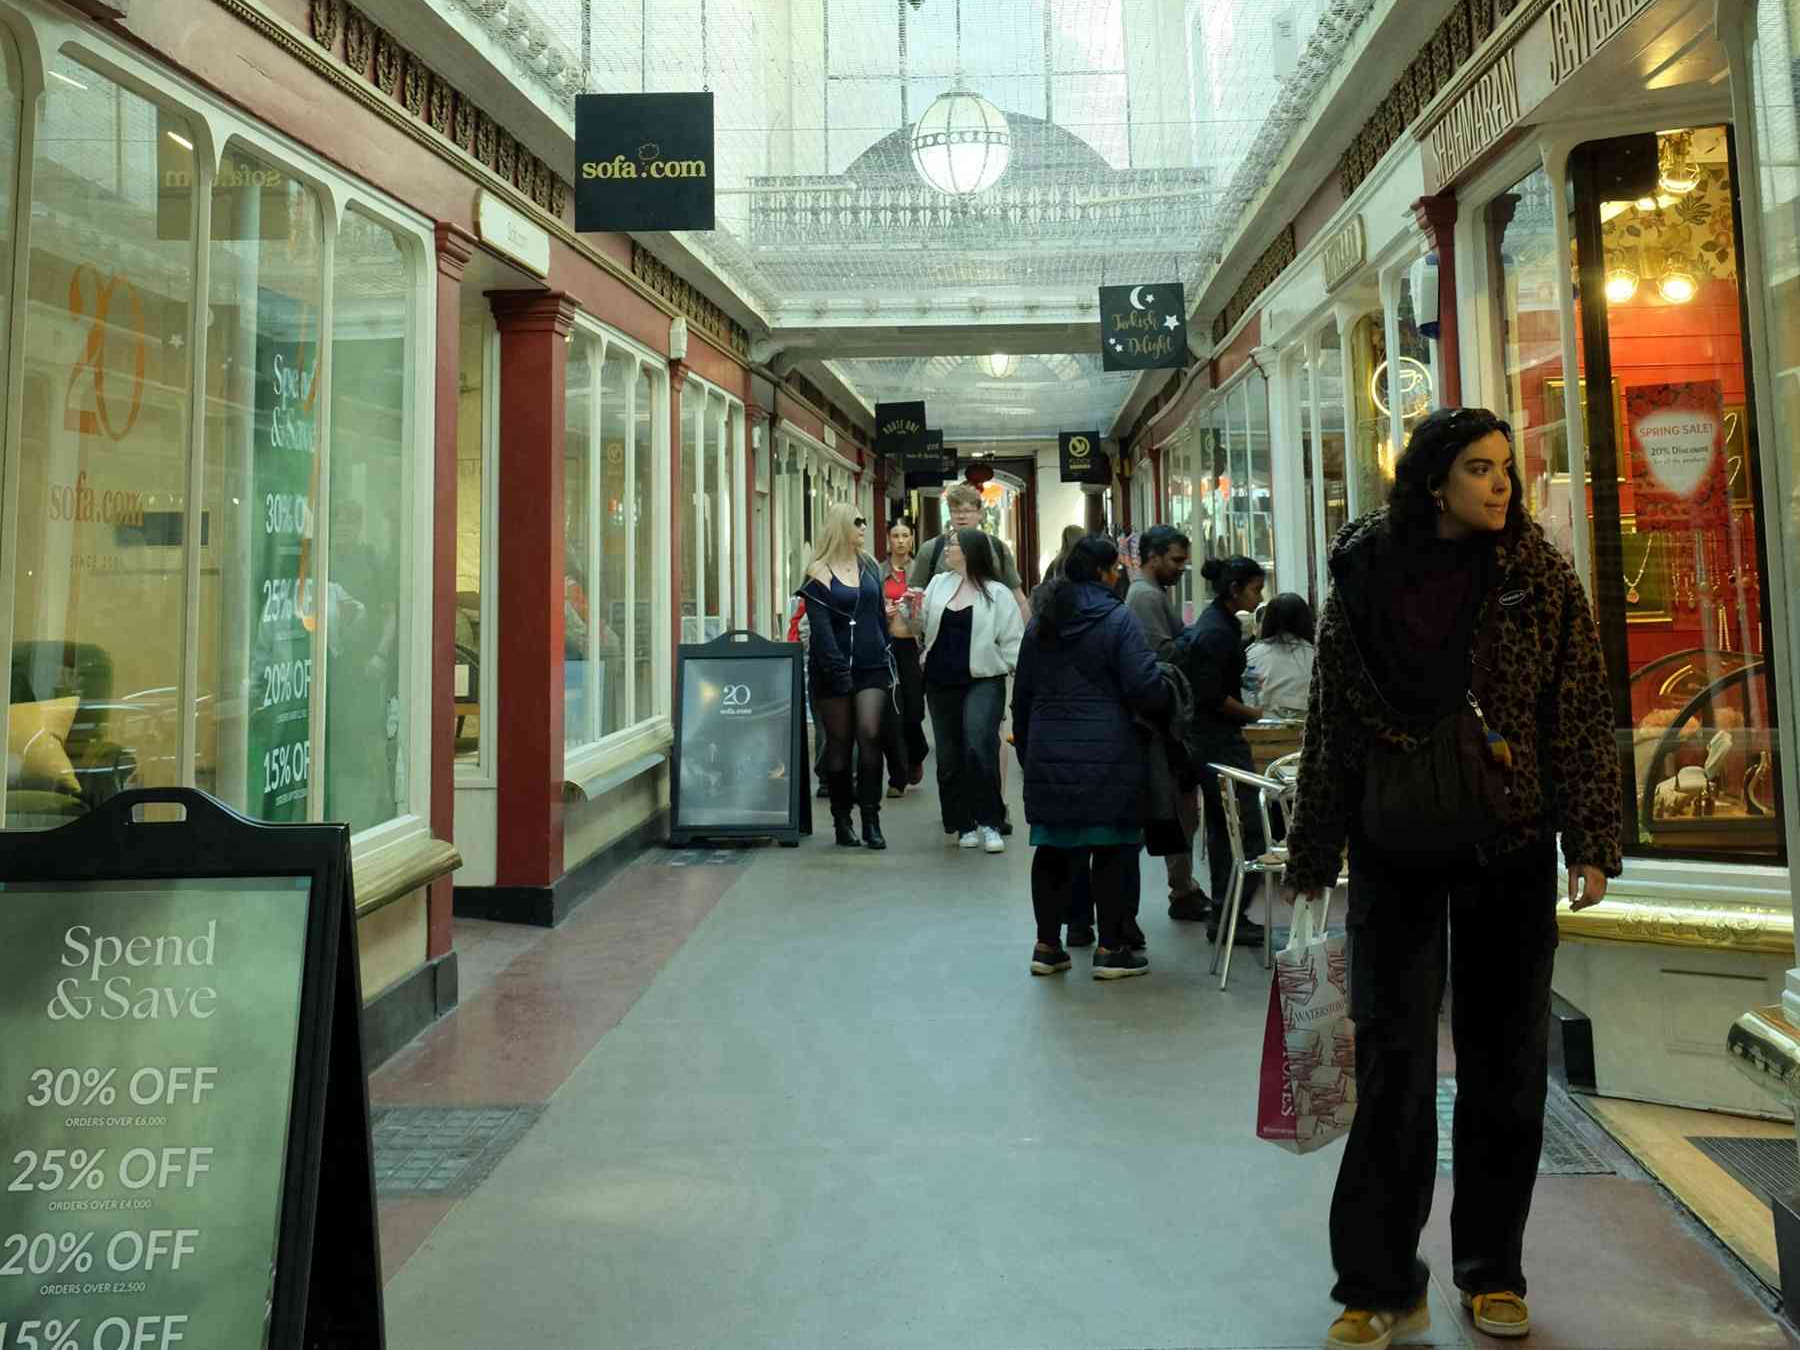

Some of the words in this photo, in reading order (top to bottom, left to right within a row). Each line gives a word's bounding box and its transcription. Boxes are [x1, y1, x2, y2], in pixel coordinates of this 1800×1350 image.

[1432, 48, 1520, 188] SHAHMARAN
[582, 155, 706, 179] sofa.com
[64, 263, 145, 442] 20
[1126, 334, 1173, 360] Delight
[1640, 425, 1680, 438] SPRING
[48, 470, 144, 527] sofa.com
[262, 578, 293, 623] 25%
[263, 661, 292, 707] 20%
[723, 684, 751, 706] 20
[263, 743, 291, 794] 15%
[61, 919, 217, 982] Spend
[100, 976, 217, 1020] Save
[27, 1067, 118, 1107] 30%
[129, 1067, 218, 1105] OFF
[65, 1117, 104, 1128] ORDERS
[106, 1116, 132, 1127] OVER
[8, 1148, 107, 1192] 25%
[119, 1147, 214, 1190] OFF
[48, 1200, 87, 1211] ORDERS
[90, 1200, 118, 1210] OVER
[0, 1231, 95, 1275] 20%
[106, 1229, 200, 1272] OFF
[40, 1283, 81, 1295] ORDERS
[83, 1283, 111, 1294] OVER
[93, 1315, 189, 1350] OFF
